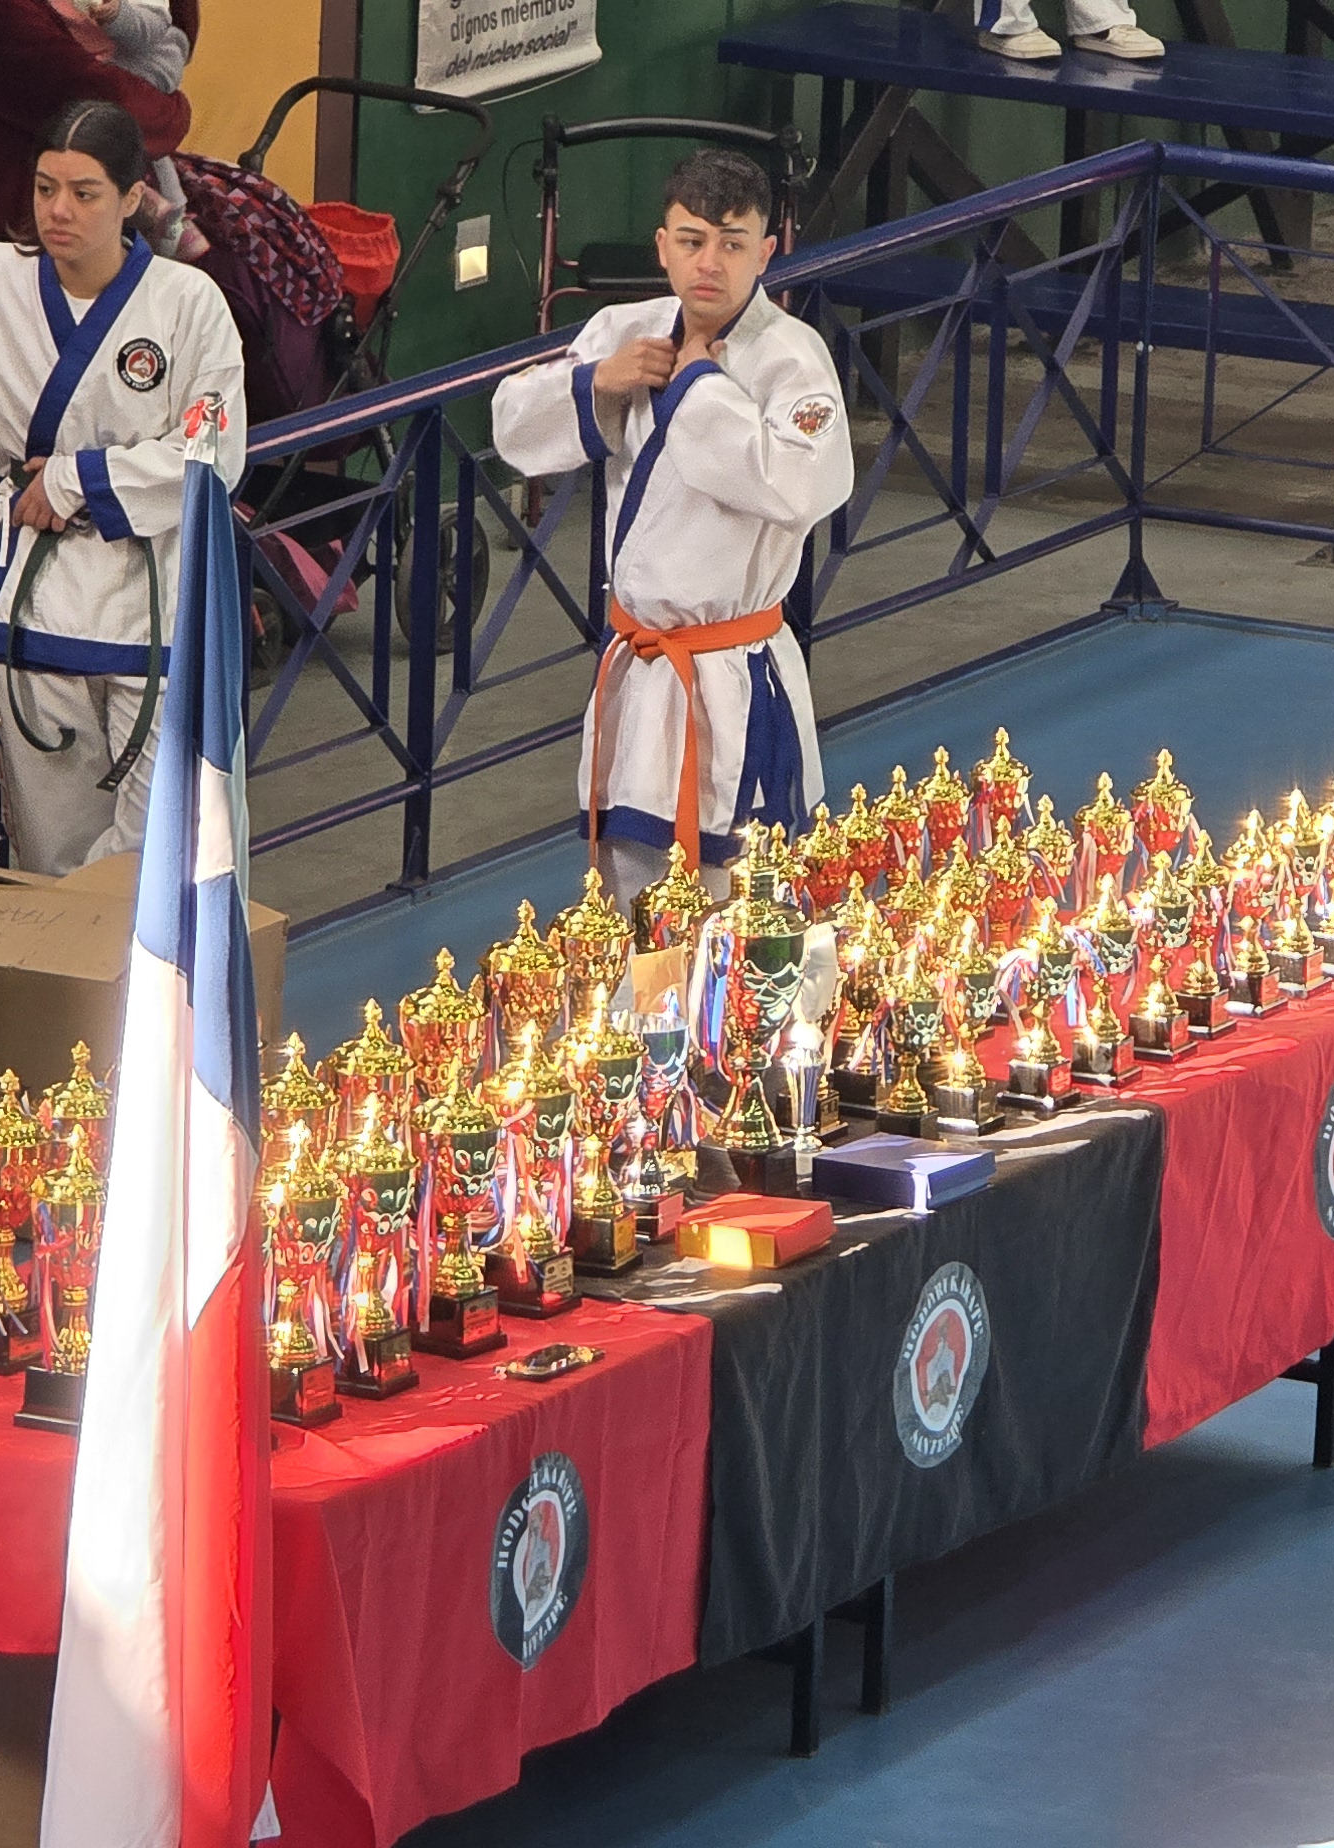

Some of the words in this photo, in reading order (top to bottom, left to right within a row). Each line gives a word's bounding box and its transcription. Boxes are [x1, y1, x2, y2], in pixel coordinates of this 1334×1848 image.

[450, 11, 498, 45] dignos
[501, 0, 575, 27] miembros
[446, 49, 472, 78] del
[470, 39, 524, 70] núcleo
